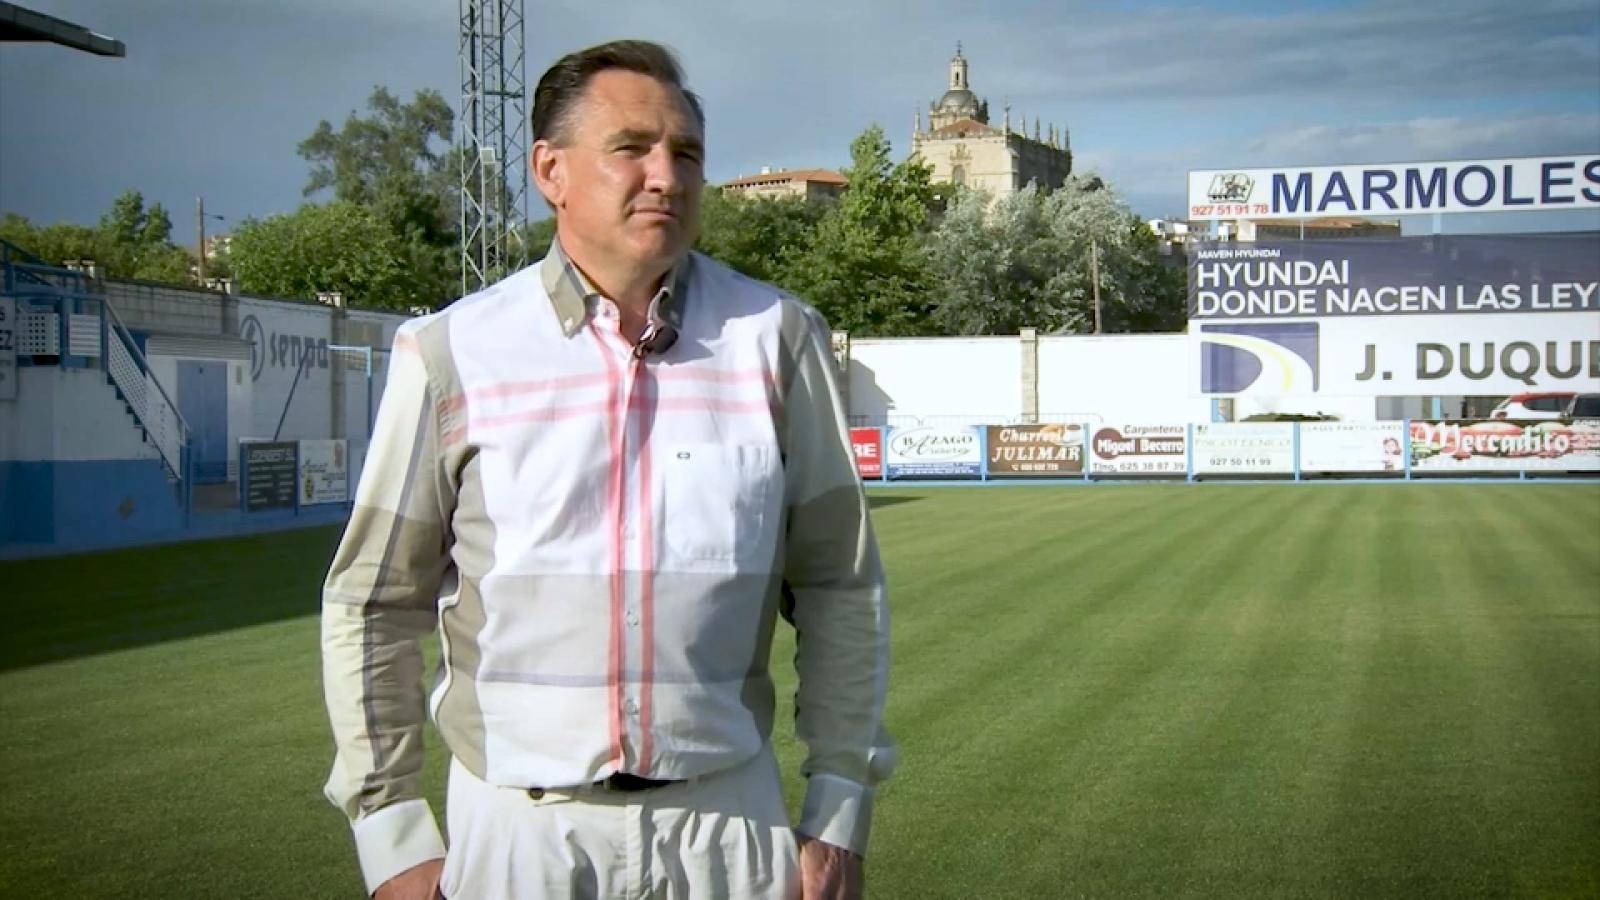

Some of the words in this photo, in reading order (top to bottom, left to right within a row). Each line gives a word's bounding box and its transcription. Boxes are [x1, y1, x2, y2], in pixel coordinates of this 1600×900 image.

[1271, 159, 1600, 213] MARMOLES
[1191, 206, 1213, 215] 927
[1217, 206, 1231, 215] 51
[1235, 205, 1249, 214] 91
[1254, 204, 1269, 213] 78
[1198, 250, 1233, 259] MAVEN
[1235, 248, 1280, 258] HYUNDAI
[1197, 260, 1349, 287] HYUNDAI
[1197, 289, 1316, 315] DONDE
[1326, 286, 1446, 313] NACEN
[1456, 284, 1522, 311] LAS
[1531, 282, 1600, 309] LEY
[1355, 343, 1393, 381] J.
[1097, 439, 1136, 456] Miguel
[1416, 422, 1569, 454] Mercadito
[991, 446, 1081, 463] JULIMAR
